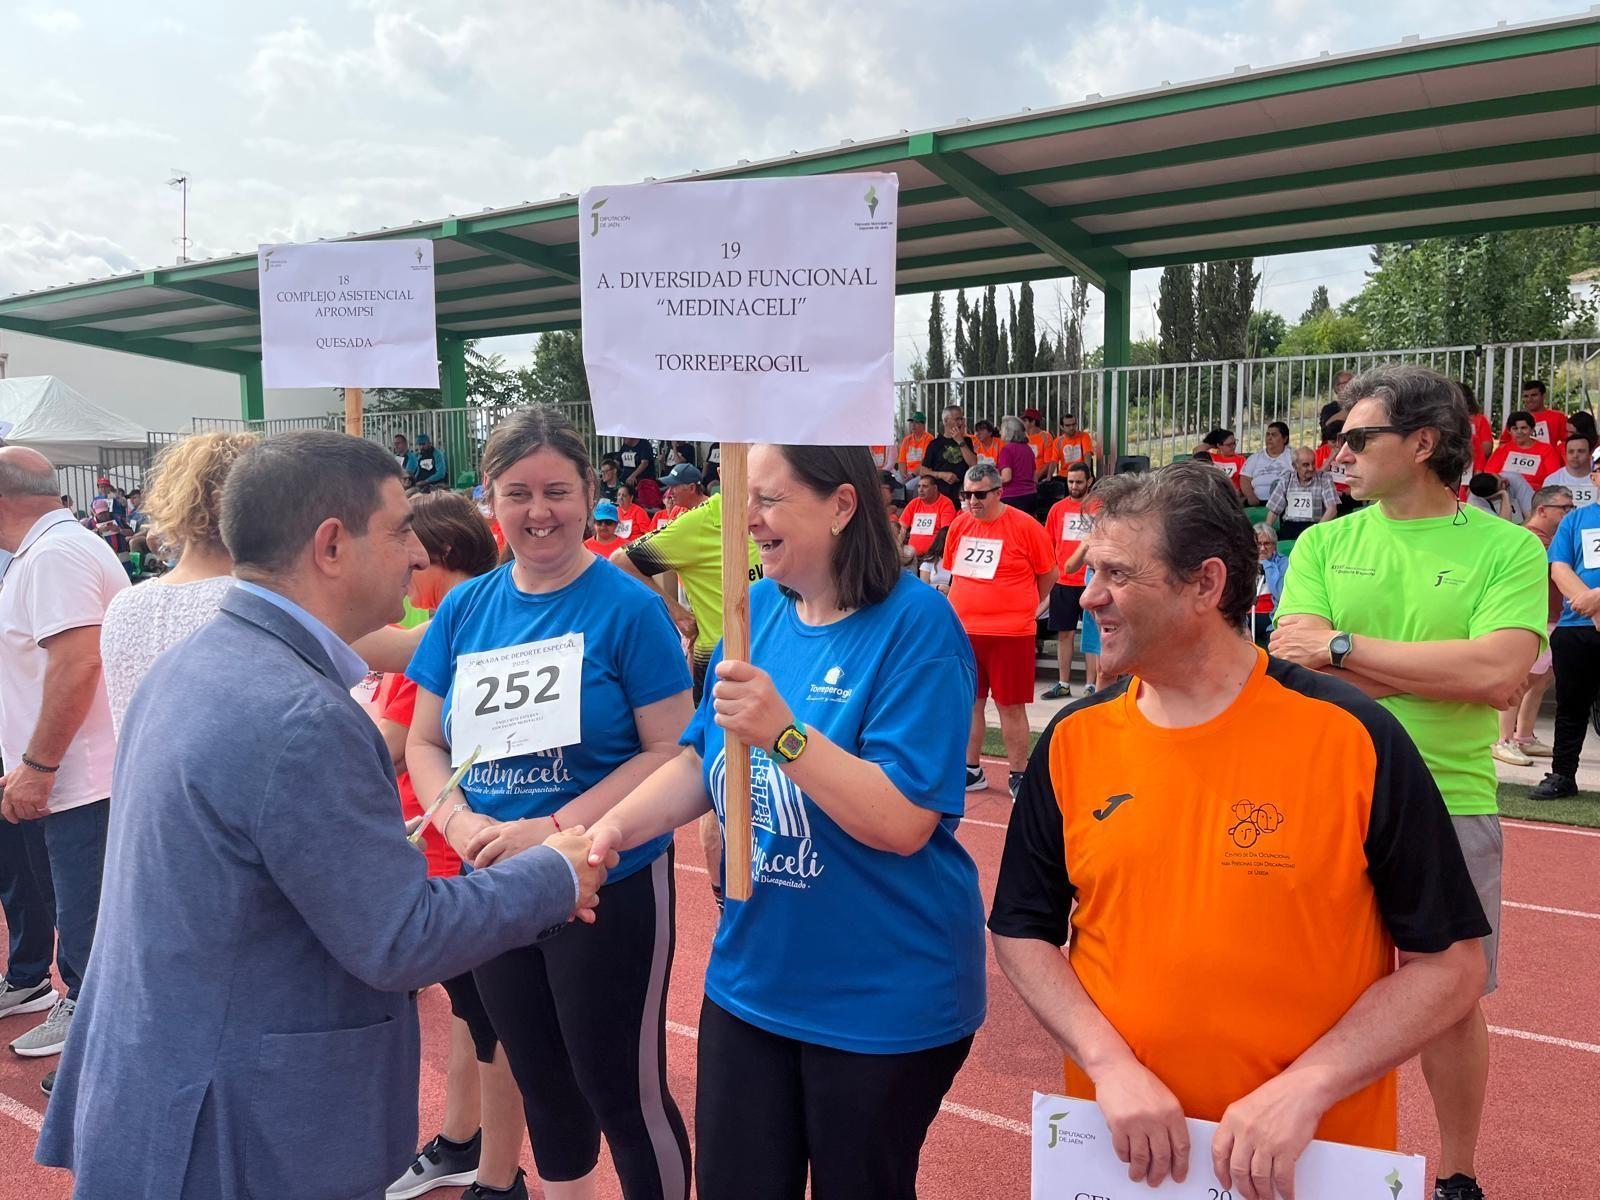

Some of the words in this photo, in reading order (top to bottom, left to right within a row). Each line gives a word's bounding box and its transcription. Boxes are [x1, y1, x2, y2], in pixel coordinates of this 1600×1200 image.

[720, 241, 741, 260] 19
[338, 276, 350, 286] 18
[597, 273, 615, 289] A.
[620, 270, 742, 289] DIVERSIDAD
[748, 268, 878, 287] FUNCIONAL
[276, 290, 336, 304] COMPLEJO
[339, 289, 415, 301] ASISTENCIAL
[315, 306, 374, 318] APROMPSI
[316, 337, 373, 350] QUESADA
[655, 354, 810, 373] TORREPEROGIL
[1512, 457, 1535, 467] 160
[1293, 498, 1311, 508] 278
[916, 518, 933, 528] 269
[964, 548, 994, 564] 273
[500, 654, 510, 662] DE
[511, 647, 540, 659] DEPORTE
[474, 665, 560, 717] 252
[1058, 1129, 1096, 1141] DIPUTACIÓN
[1068, 1137, 1084, 1146] JAÉN
